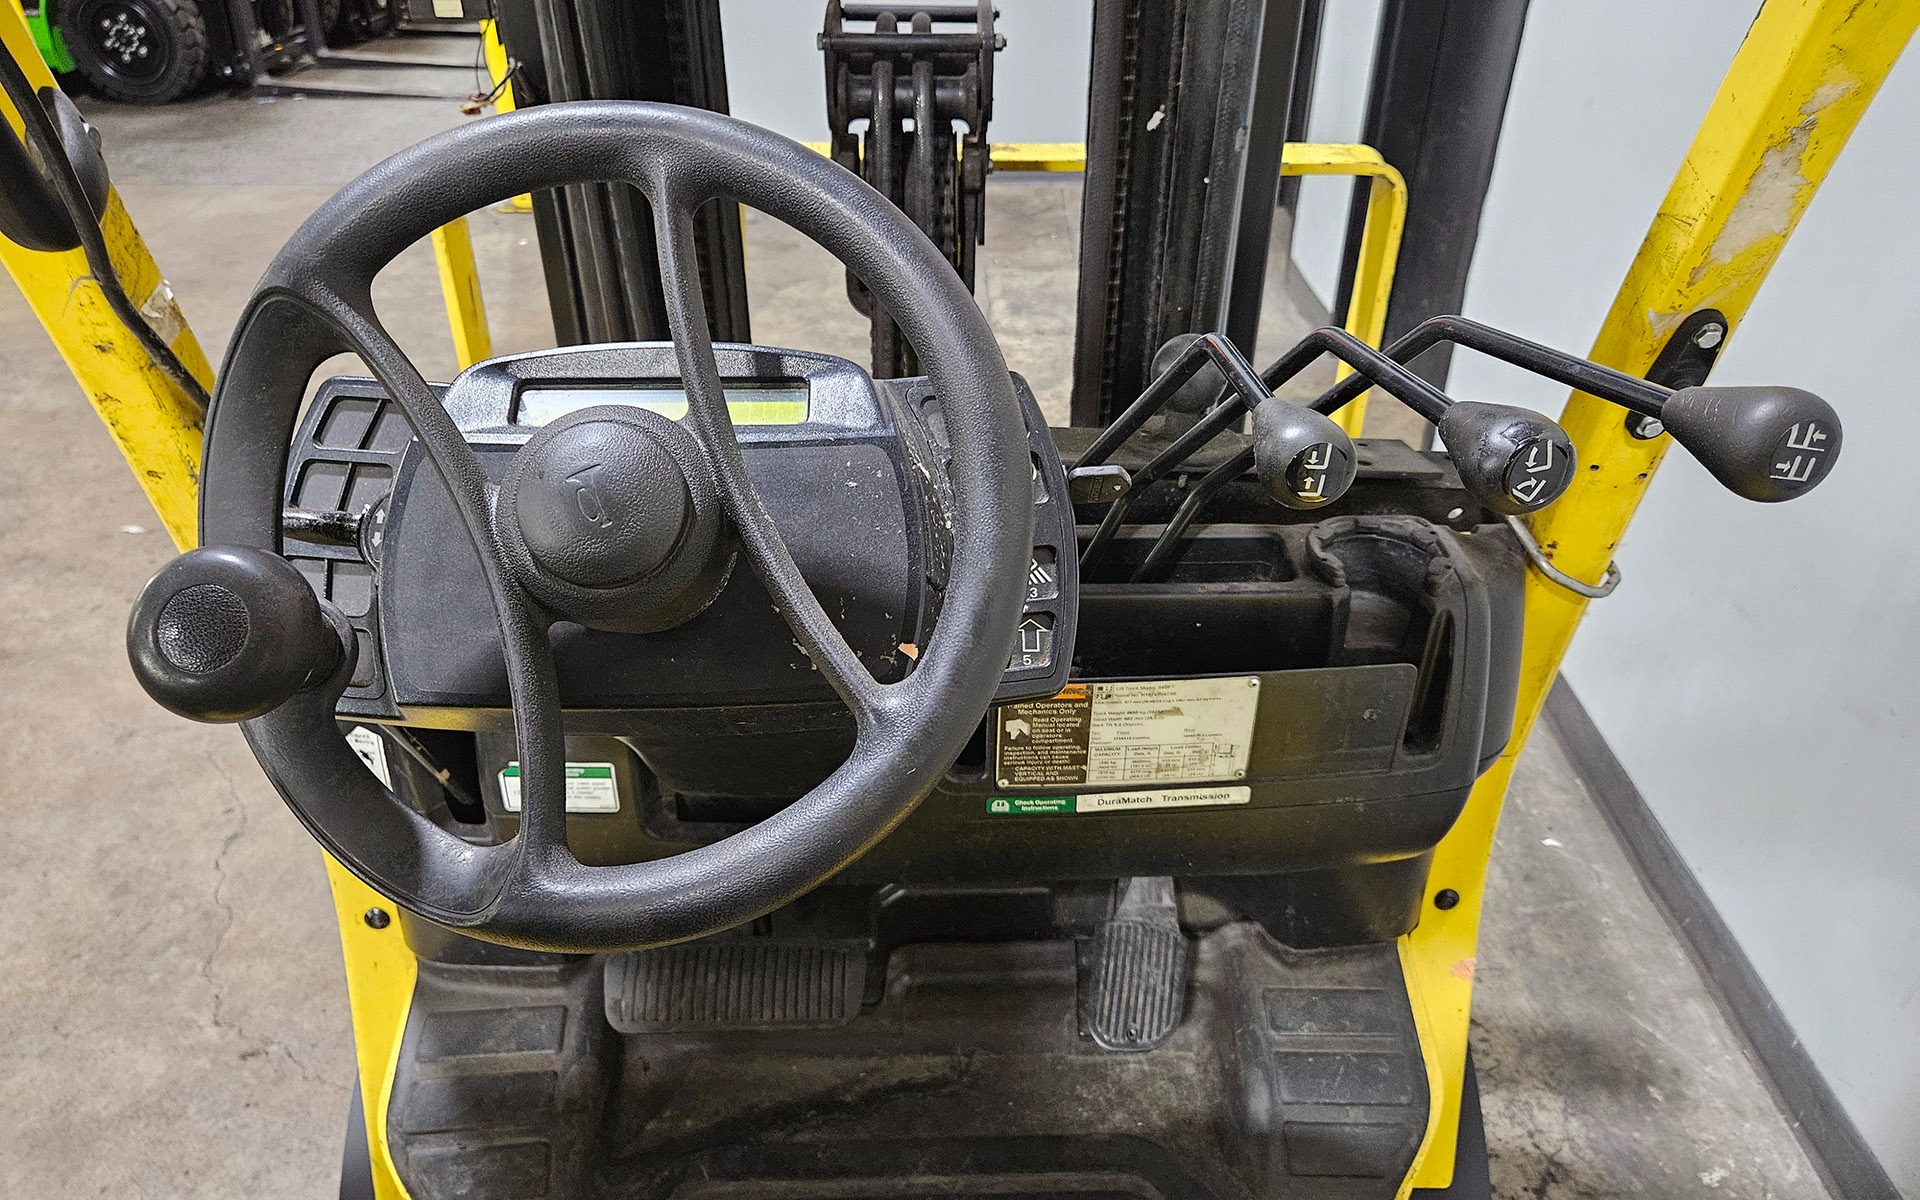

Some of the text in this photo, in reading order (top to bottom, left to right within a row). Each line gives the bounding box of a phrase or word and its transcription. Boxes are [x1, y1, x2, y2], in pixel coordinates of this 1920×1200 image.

[1029, 587, 1038, 598] 3
[1022, 654, 1032, 666] 5
[1097, 792, 1231, 806] DuraMatch Transmission
